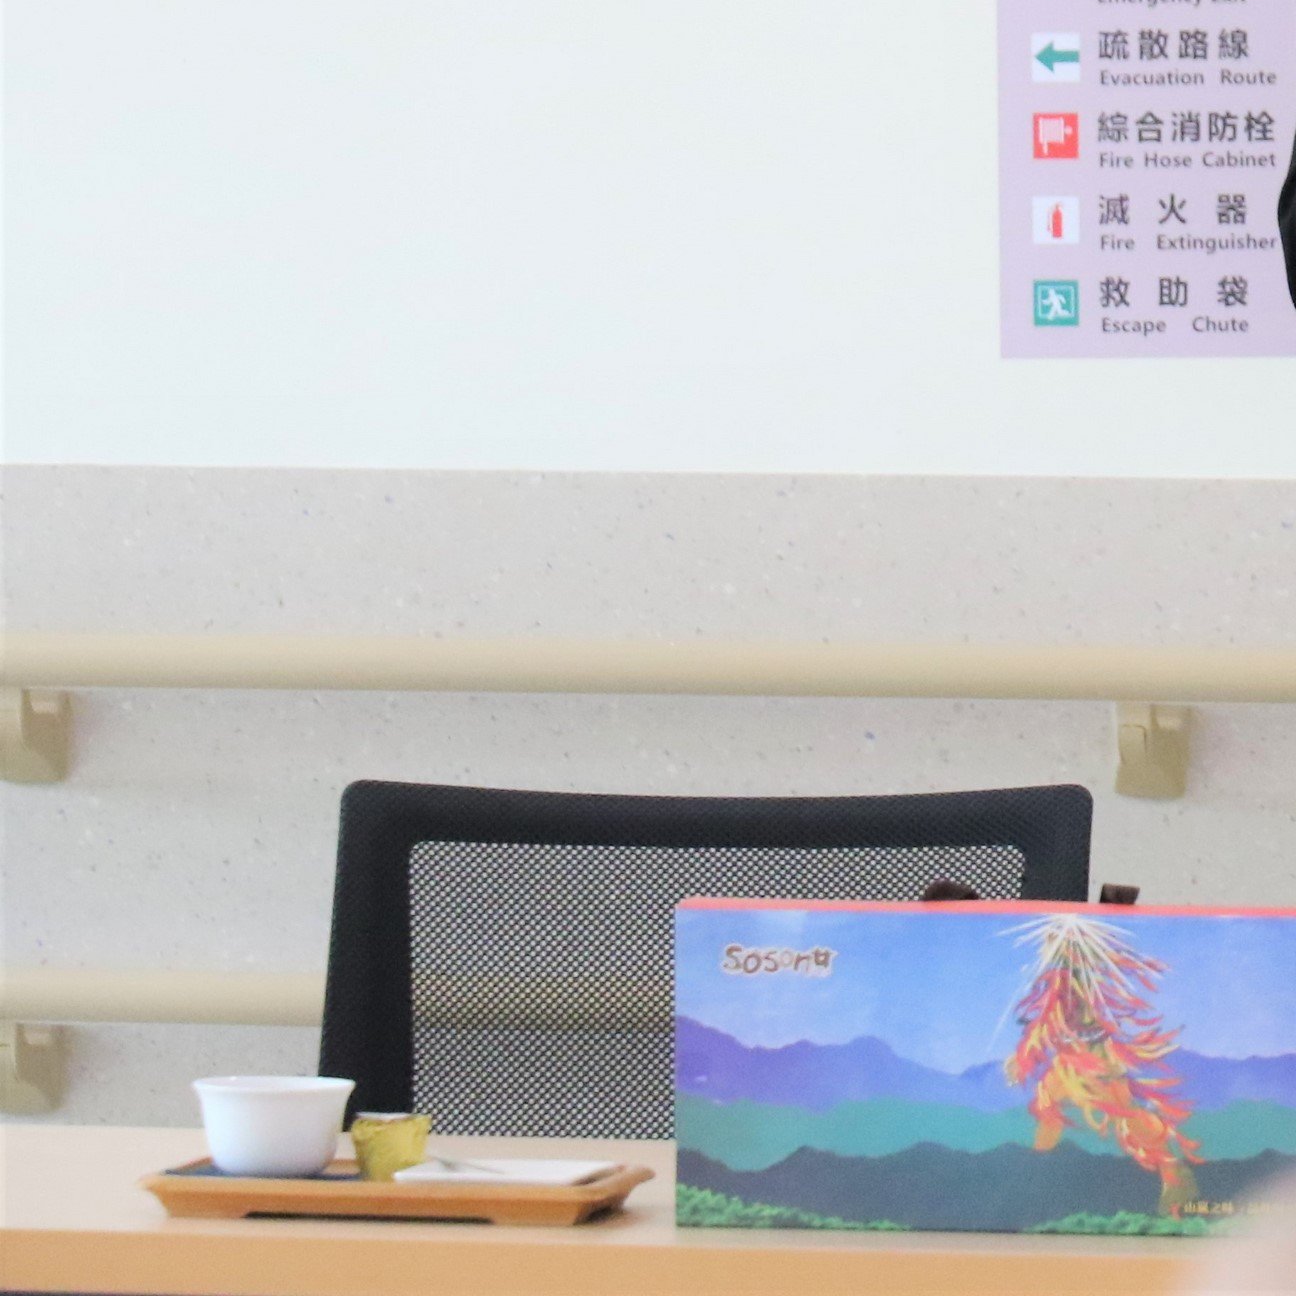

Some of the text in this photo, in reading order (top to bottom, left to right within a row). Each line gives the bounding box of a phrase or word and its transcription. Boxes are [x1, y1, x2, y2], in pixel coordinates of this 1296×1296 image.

[1099, 29, 1248, 60] 疏散路線
[1100, 68, 1277, 86] Evacuation Route
[1098, 111, 1274, 143] 綜合消防栓
[1099, 151, 1276, 168] Fire Hose Cabinet
[1099, 194, 1246, 225] 滅火器
[1100, 233, 1277, 255] Fire Extinguisher
[1100, 276, 1248, 308] 救助袋
[1101, 316, 1249, 337] Escape Chute
